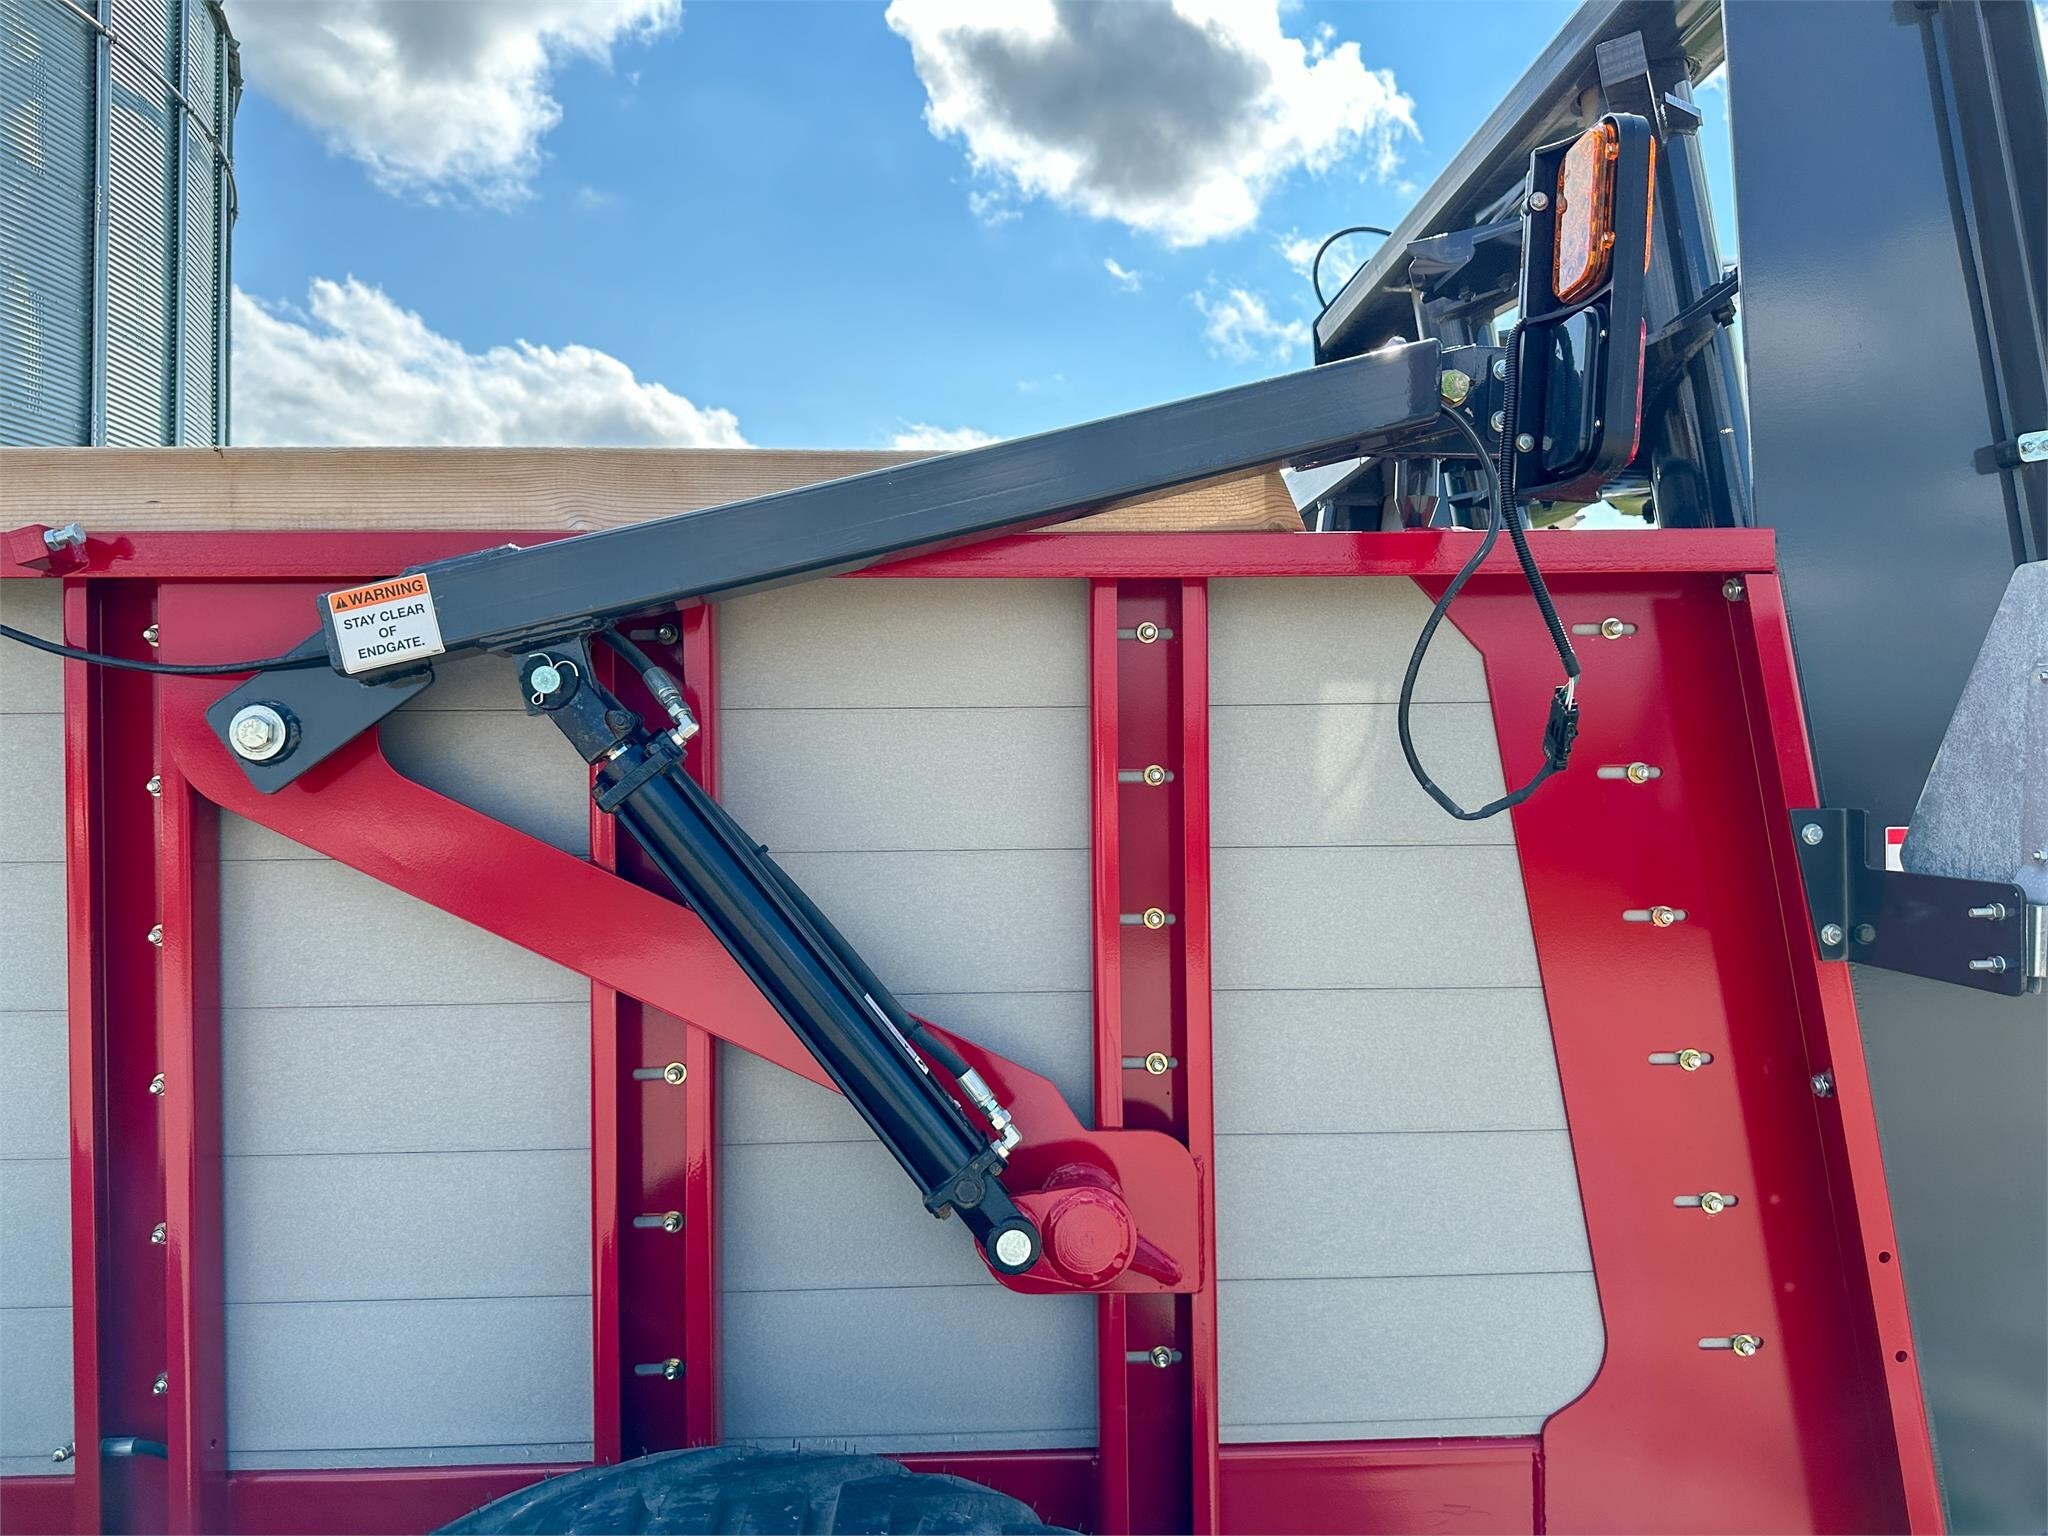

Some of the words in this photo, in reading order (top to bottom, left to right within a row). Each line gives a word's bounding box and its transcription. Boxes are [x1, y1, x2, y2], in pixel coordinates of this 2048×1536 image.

[348, 580, 424, 606] WARNING
[344, 613, 376, 630] STAY
[380, 603, 425, 622] CLEAR
[378, 625, 397, 638] OF
[358, 636, 425, 659] ENDGATE.
